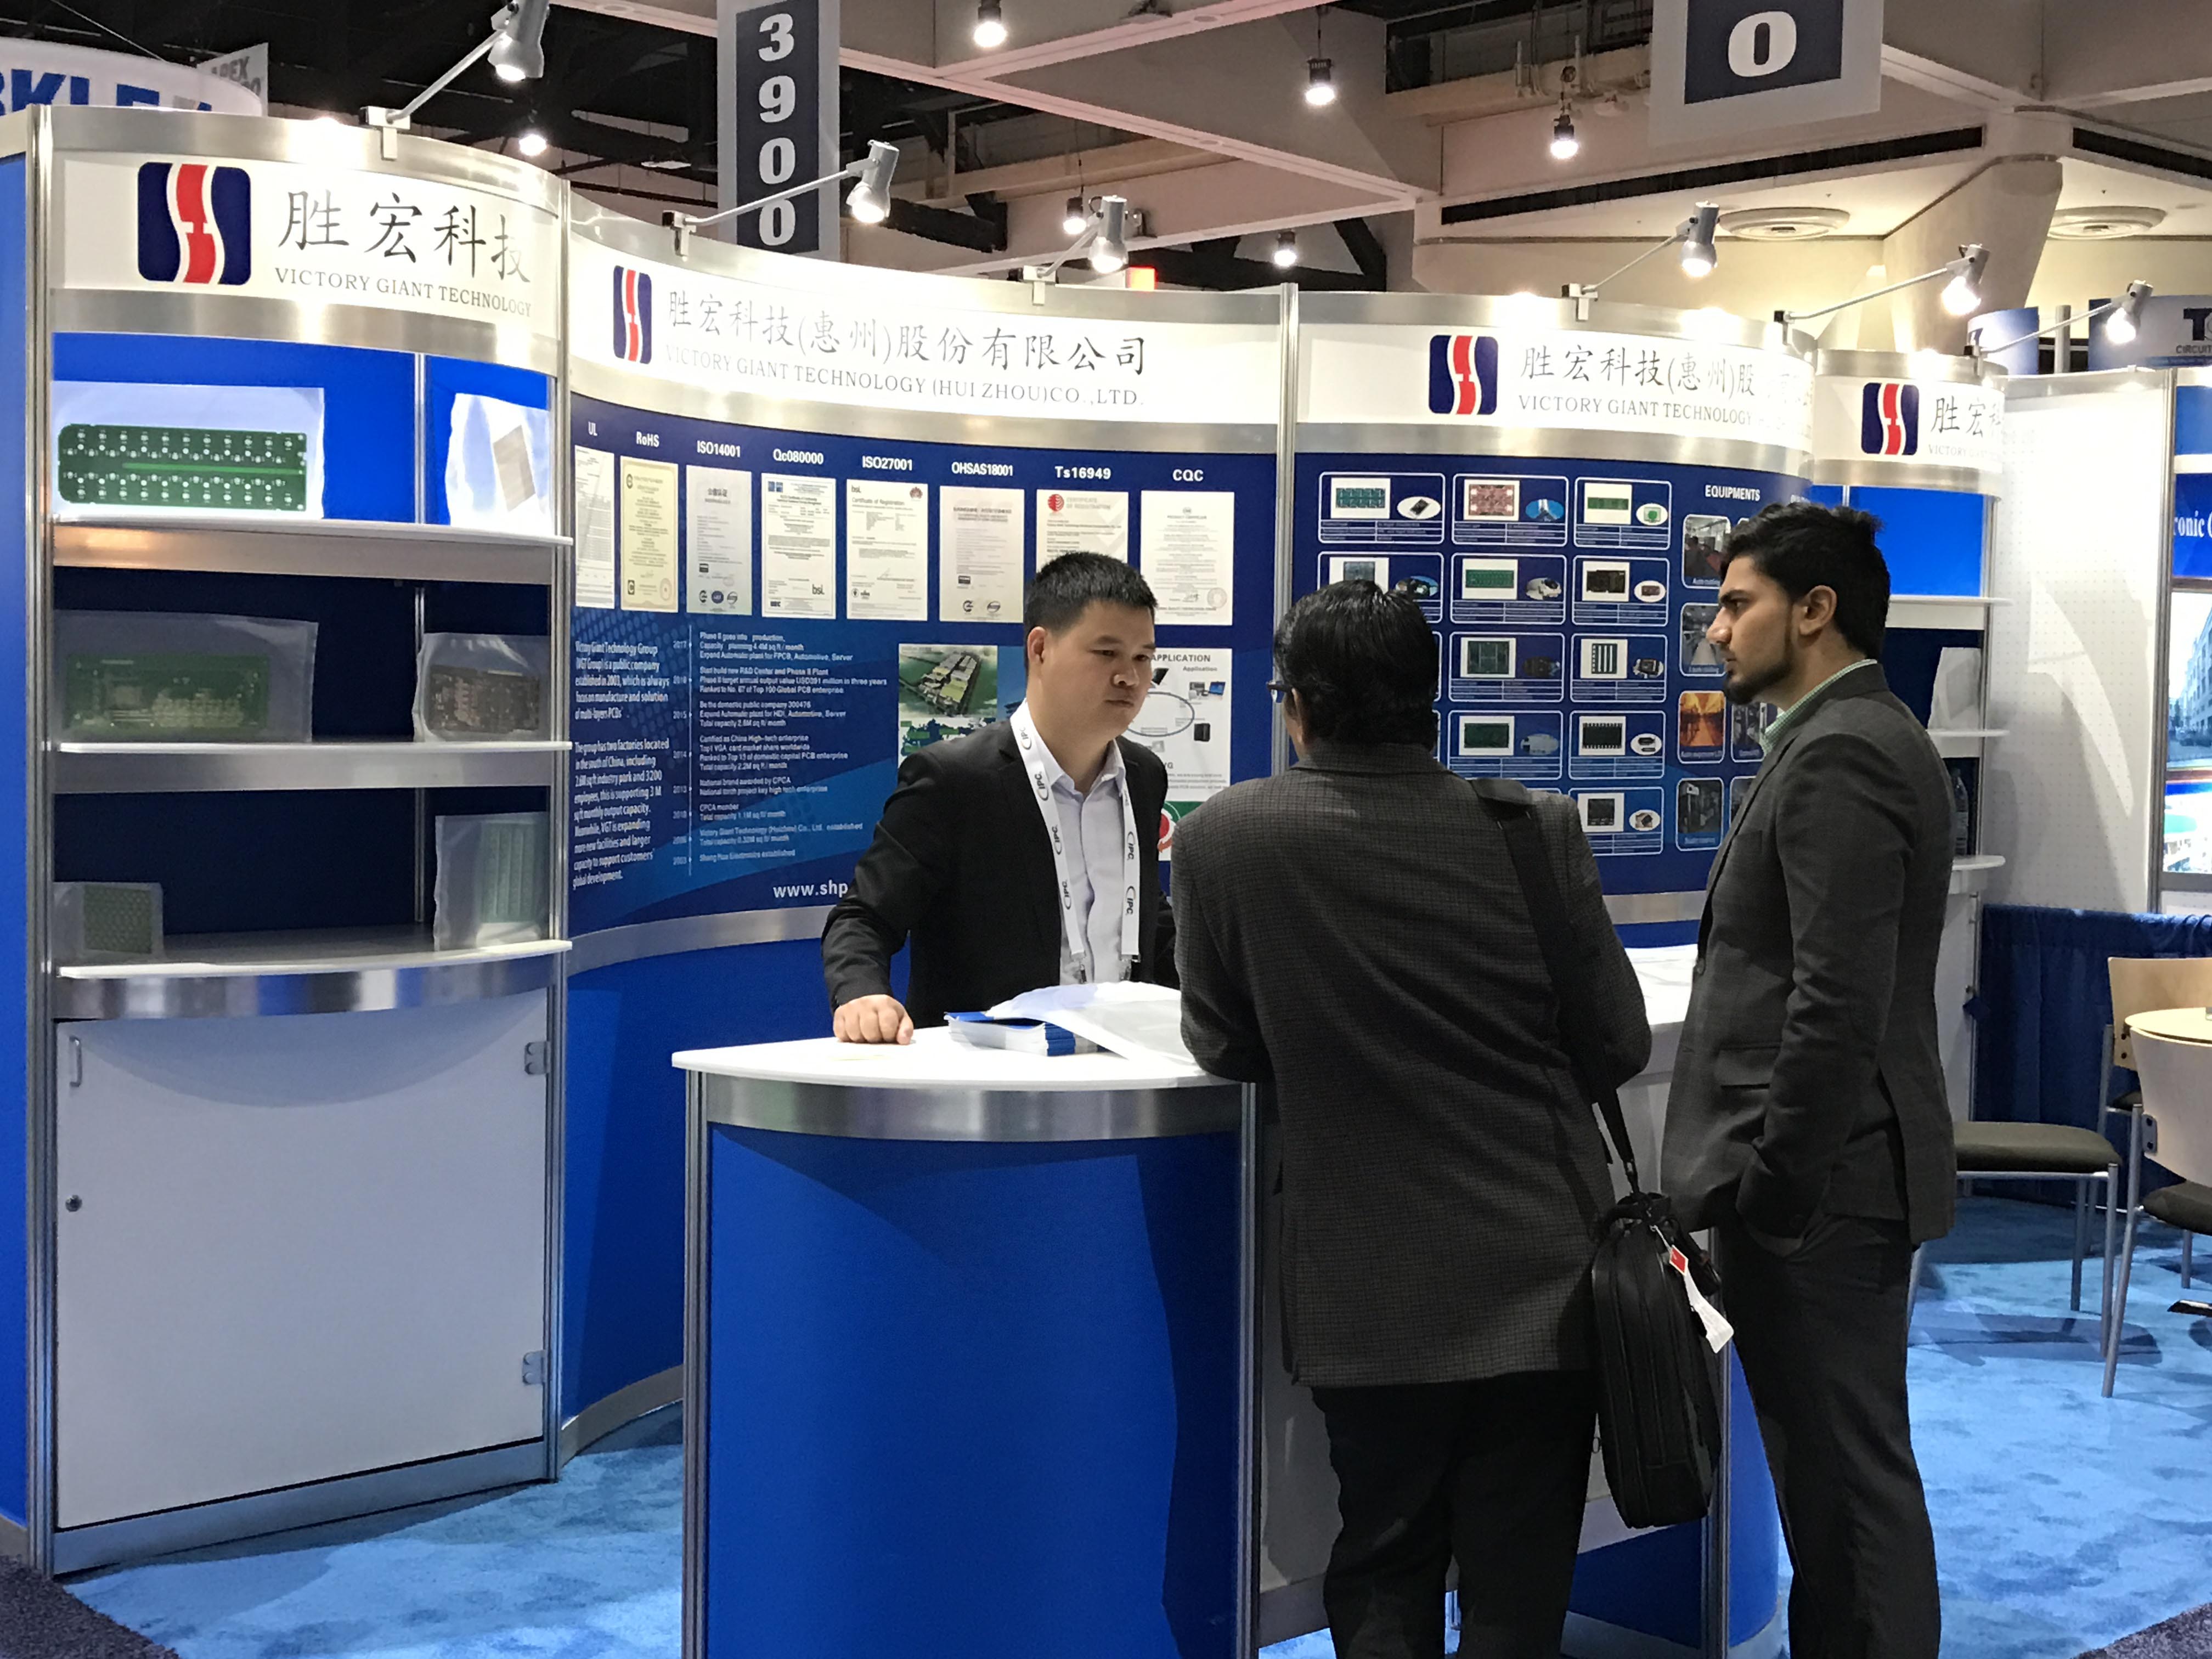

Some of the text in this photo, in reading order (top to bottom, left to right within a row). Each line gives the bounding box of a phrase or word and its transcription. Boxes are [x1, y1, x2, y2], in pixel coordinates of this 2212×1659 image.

[278, 189, 530, 283] 胜宏科技
[275, 267, 532, 318] VICTORY GIANT TECHNOLOGY
[665, 344, 731, 372] VICTORY
[737, 358, 788, 380] GIANT
[794, 365, 926, 393] TECHNOLOGY
[1519, 395, 1602, 414] VICTORY
[1608, 399, 1658, 417] GIANT
[1663, 403, 1753, 426] TECHNOLOGY
[588, 421, 597, 436] UL
[636, 431, 659, 447] RoHS
[697, 441, 741, 458] ISO14001
[772, 448, 824, 465] Qc080000
[862, 455, 912, 471] ISO27001
[951, 461, 1013, 477] OHSAS18001
[1055, 466, 1111, 480] Ts16949
[1172, 469, 1204, 482] CQC
[1705, 484, 1761, 501] EQUIPMENTS
